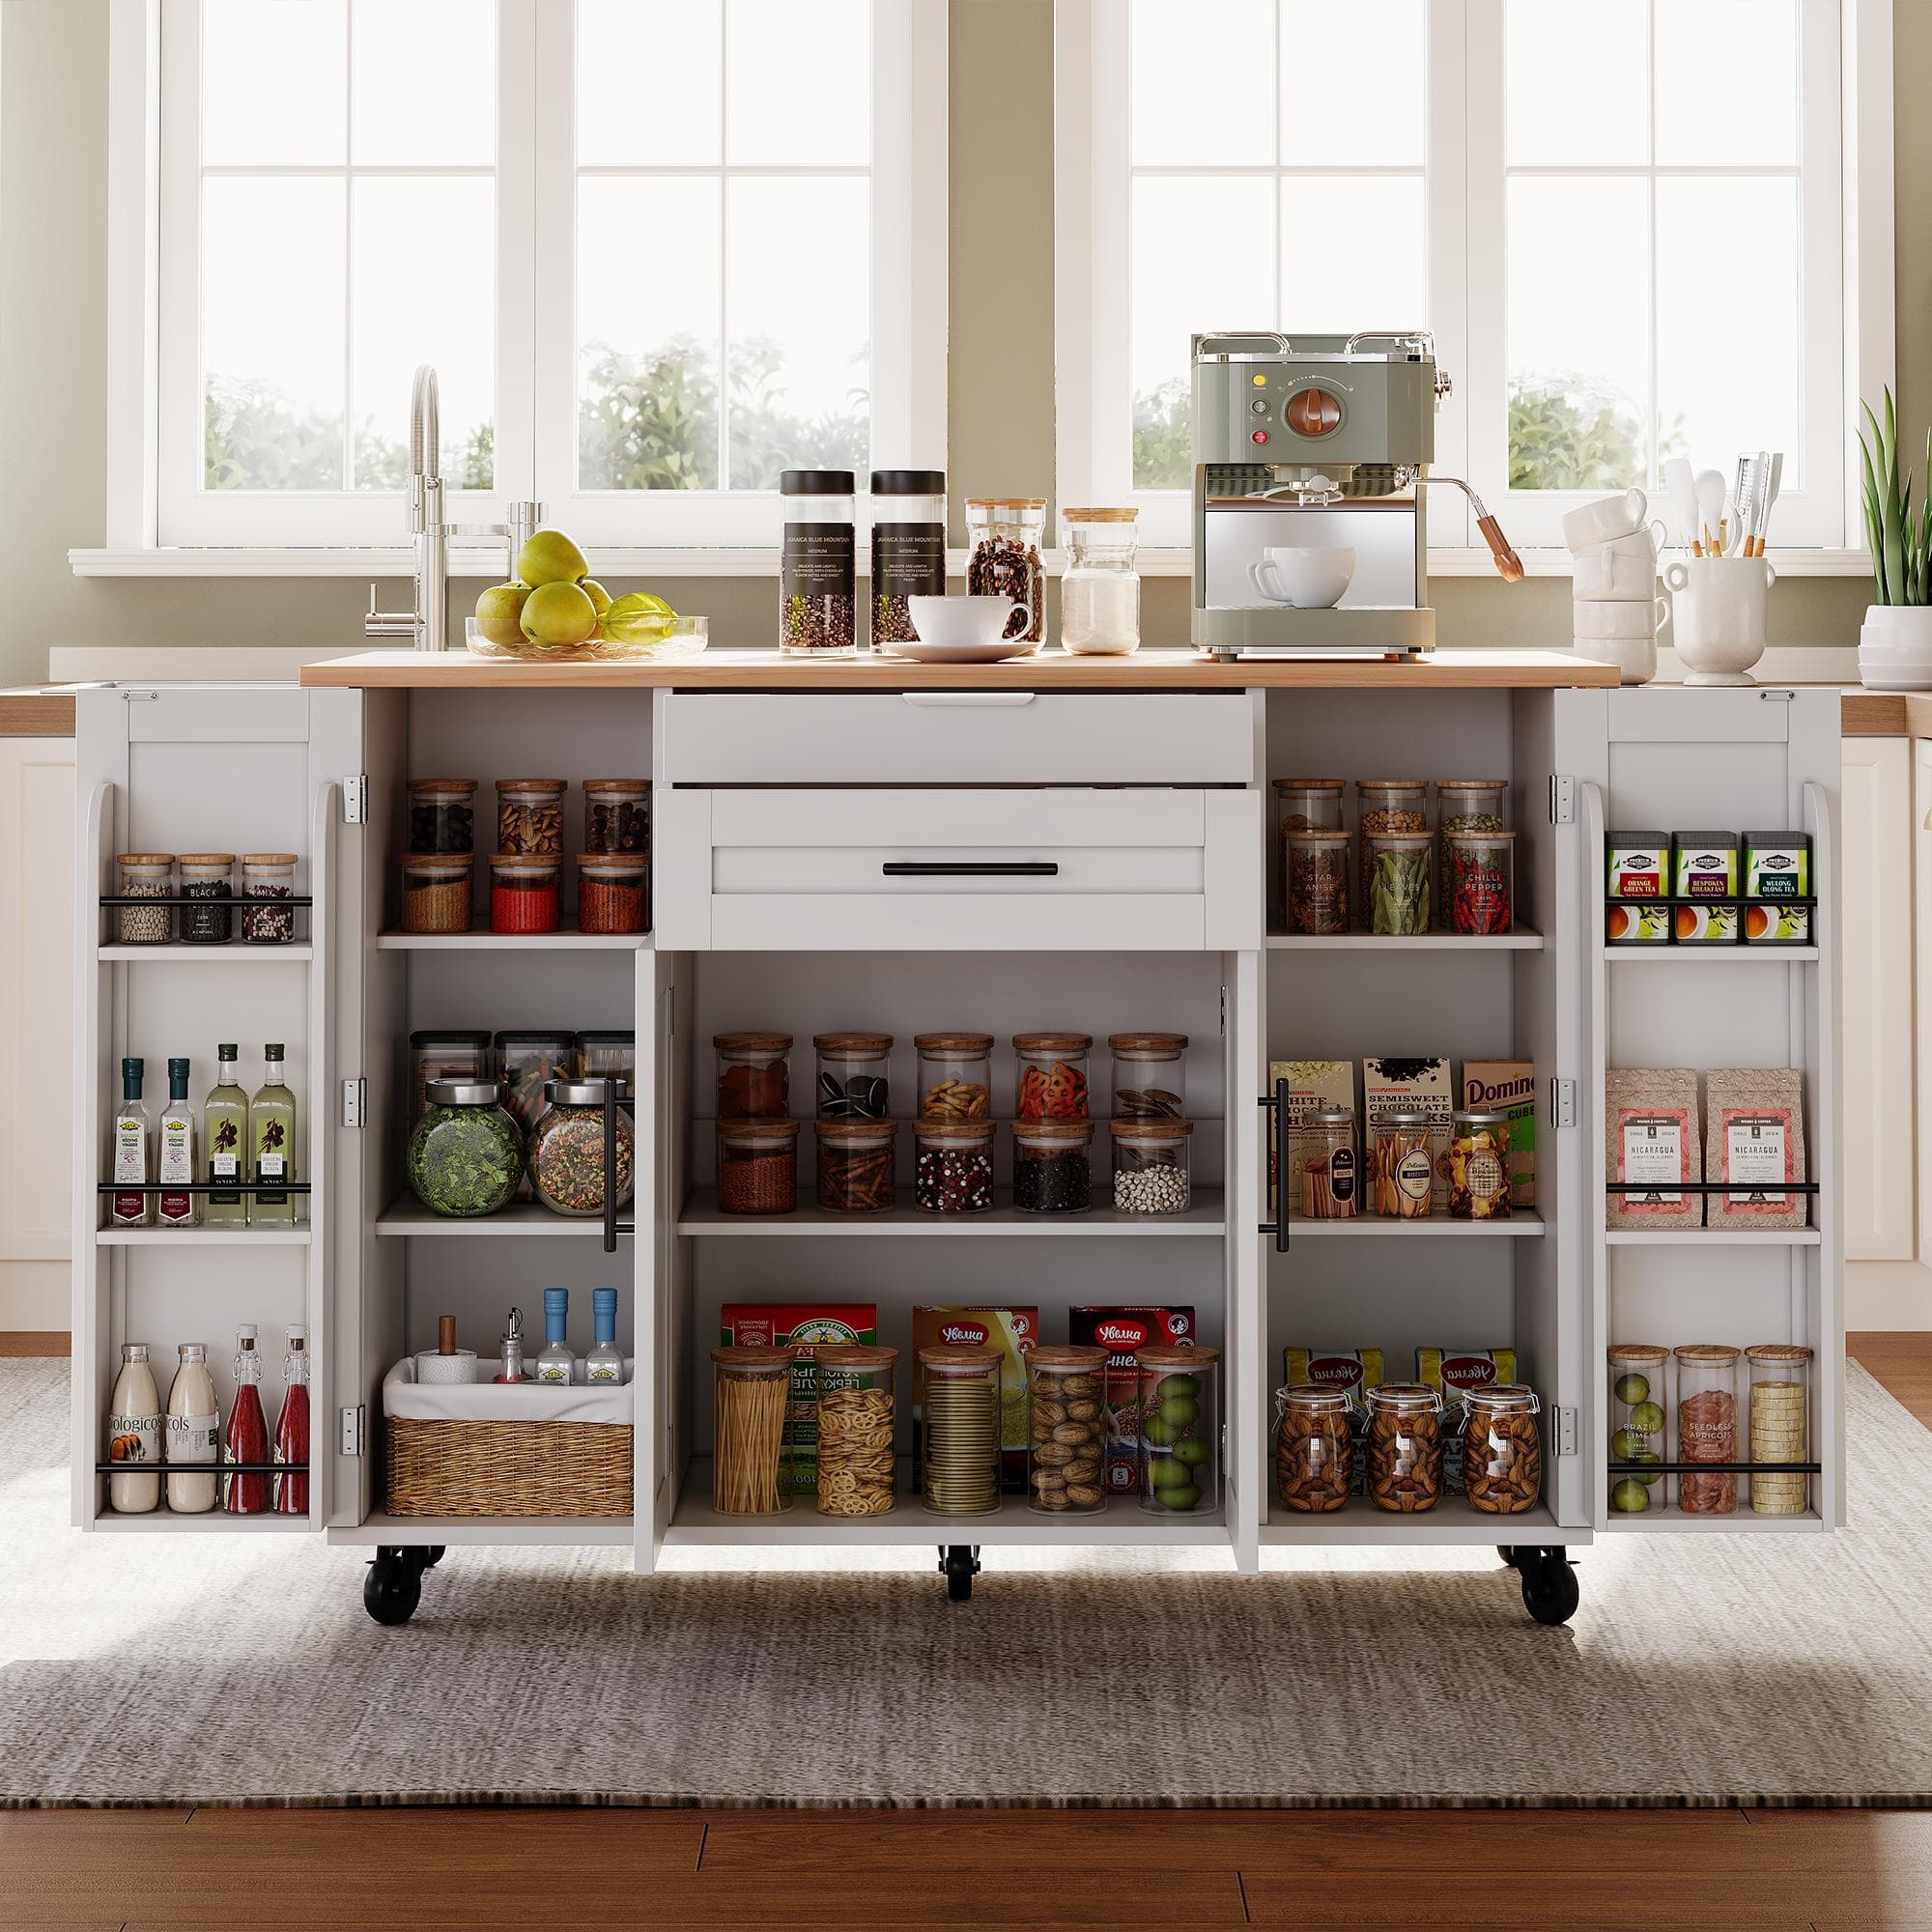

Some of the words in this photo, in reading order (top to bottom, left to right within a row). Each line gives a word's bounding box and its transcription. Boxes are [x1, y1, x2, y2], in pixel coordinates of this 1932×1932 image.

[190, 888, 217, 897] BLACK
[942, 1327, 983, 1342] Увелка
[1099, 1326, 1141, 1340] Увелка
[1118, 1471, 1123, 1479] 5
